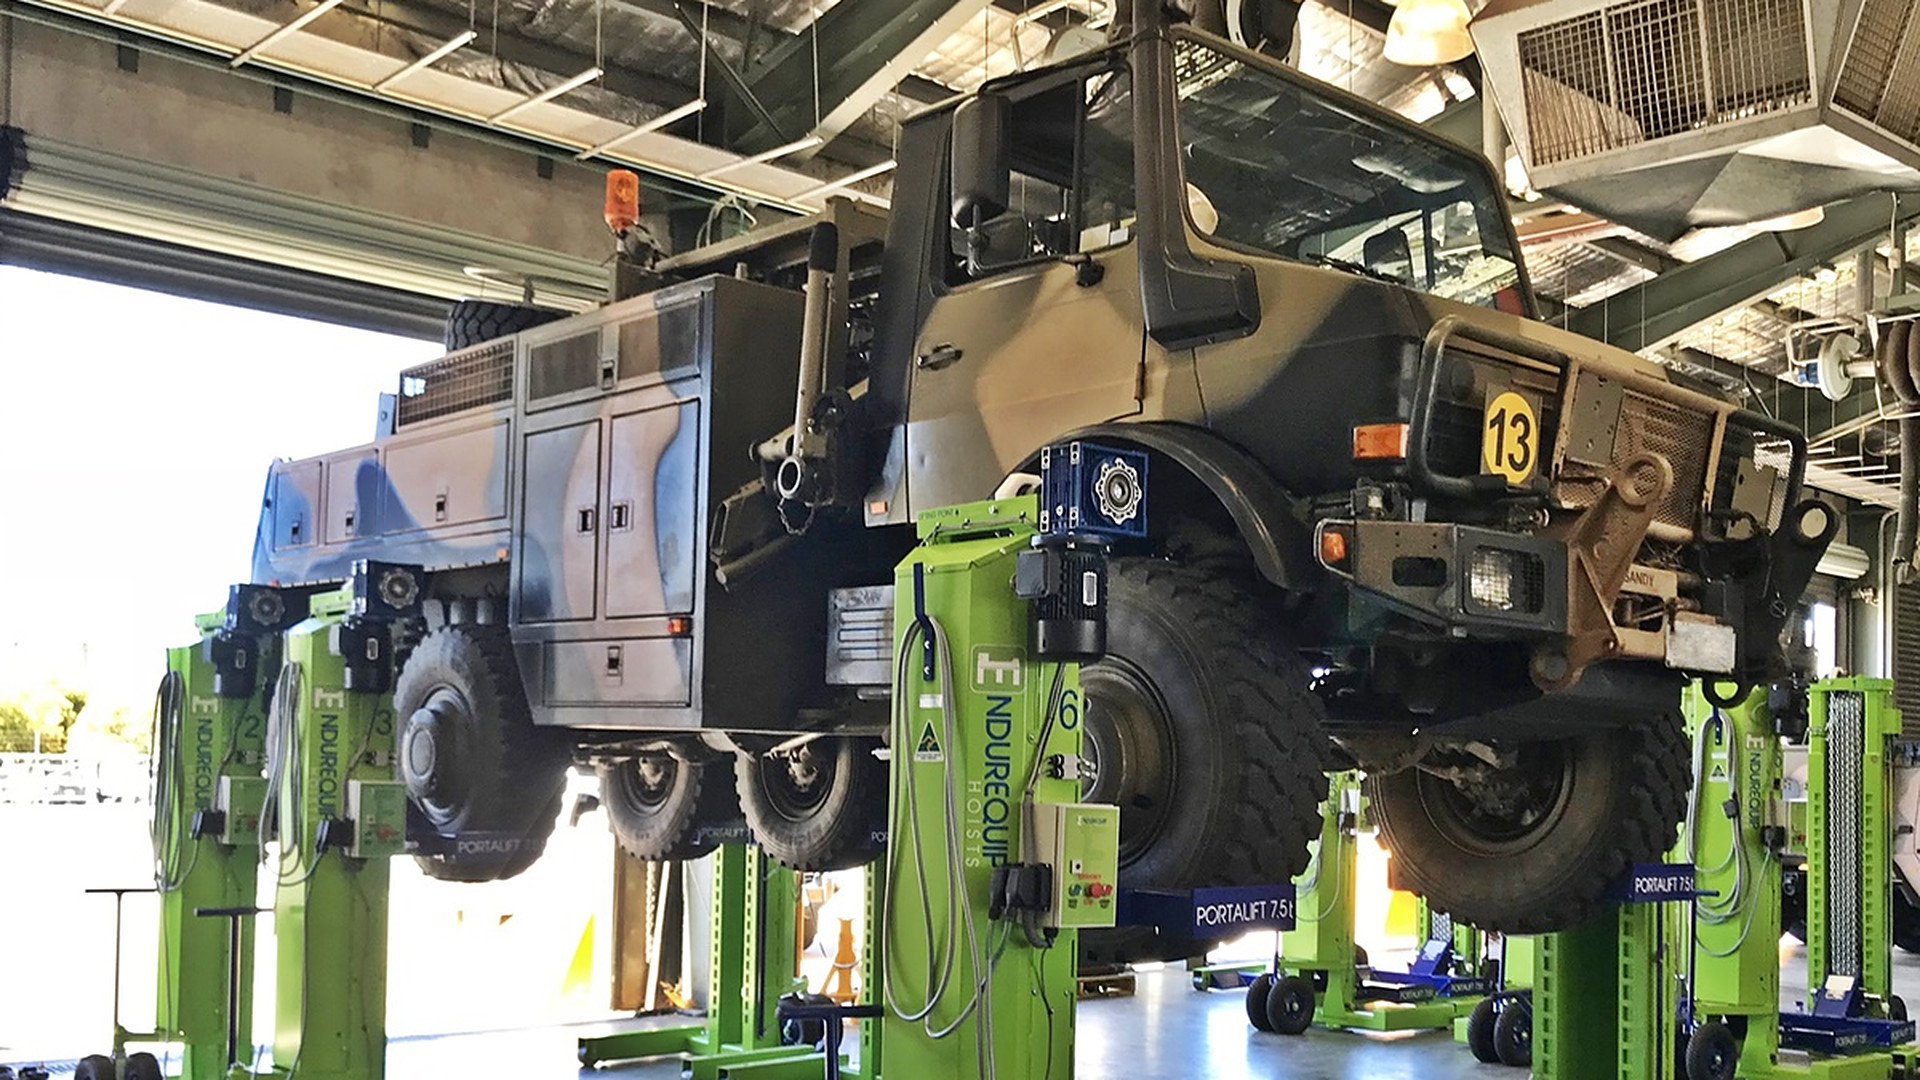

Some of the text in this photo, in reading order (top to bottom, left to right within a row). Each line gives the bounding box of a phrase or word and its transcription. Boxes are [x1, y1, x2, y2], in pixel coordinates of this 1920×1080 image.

[1490, 408, 1531, 472] 13
[376, 710, 392, 735] 3
[1059, 690, 1079, 729] 6
[245, 715, 261, 738] 2
[965, 781, 982, 867] HOISTS
[458, 839, 520, 853] PORTALIFT
[1635, 876, 1678, 893] PORTALIFT
[1196, 899, 1293, 926] PORTALIFT 7.5t
